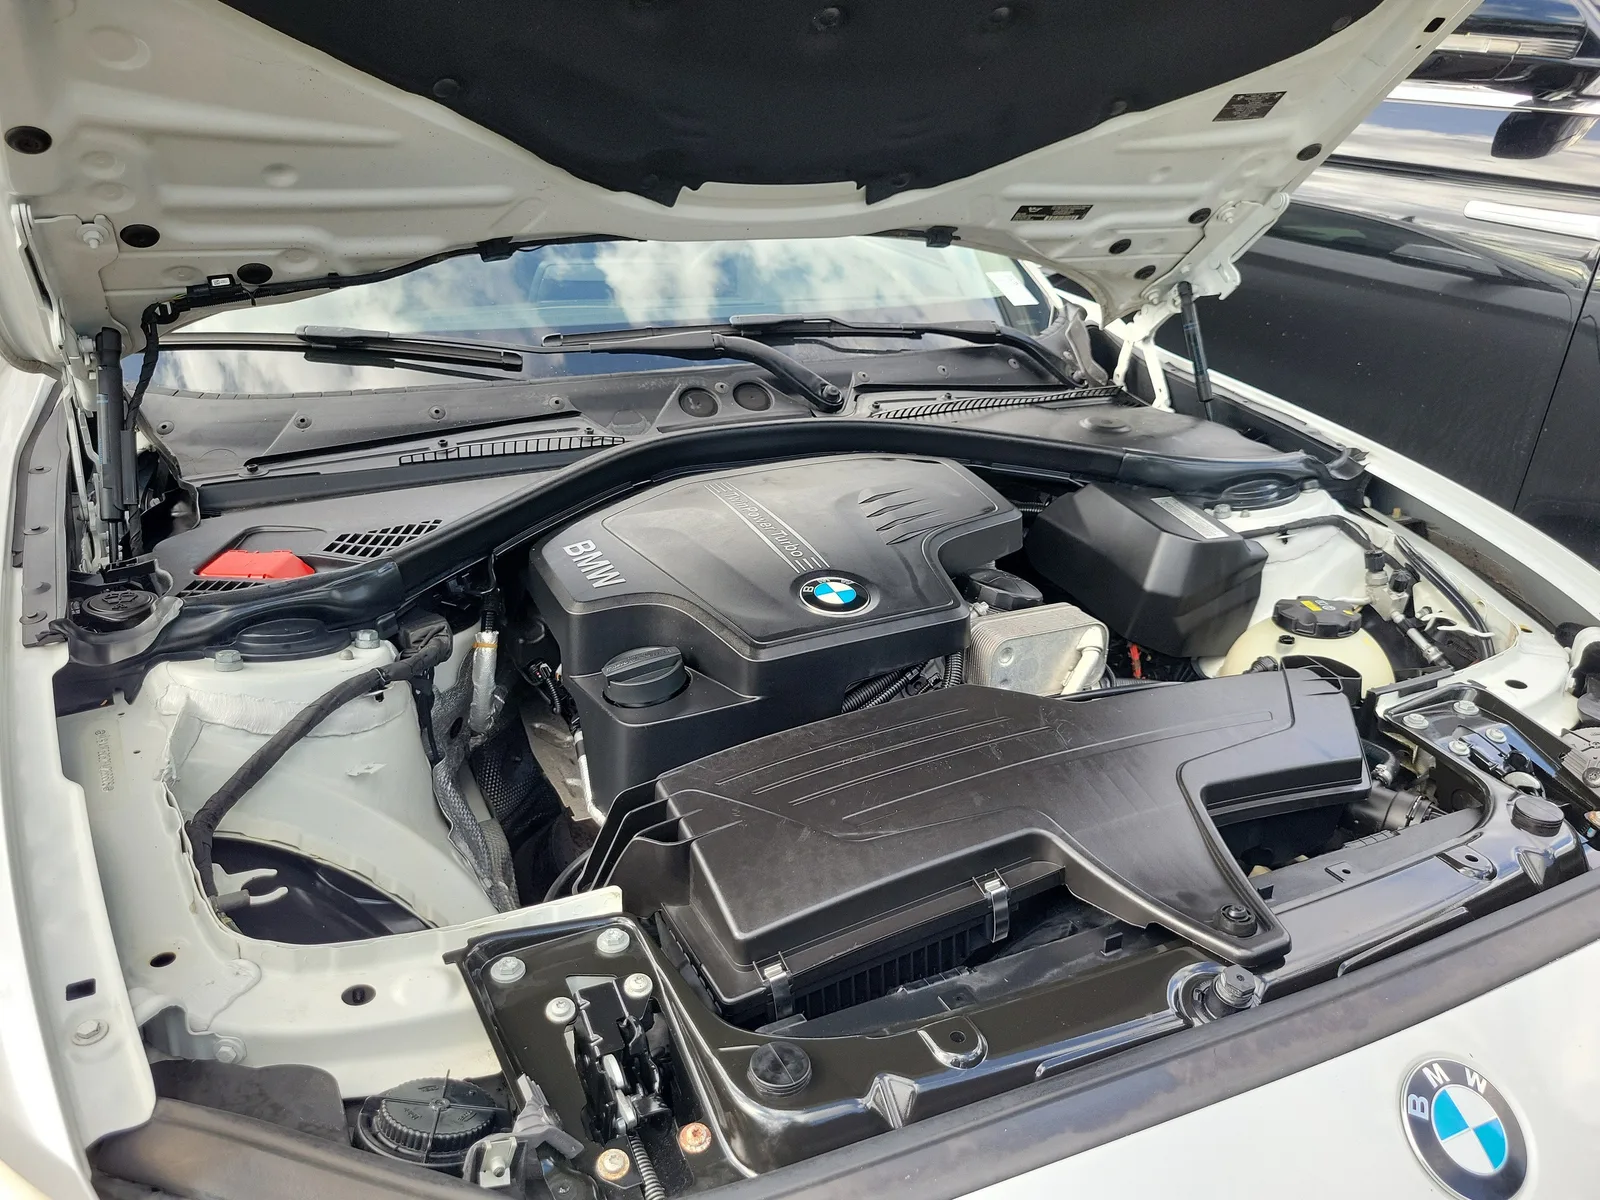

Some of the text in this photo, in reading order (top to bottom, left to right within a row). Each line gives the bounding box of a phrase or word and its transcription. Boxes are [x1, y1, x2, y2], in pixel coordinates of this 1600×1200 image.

[725, 492, 803, 557] TwinPower Turbo
[563, 540, 627, 589] BMW
[1408, 1063, 1487, 1121] BMW
